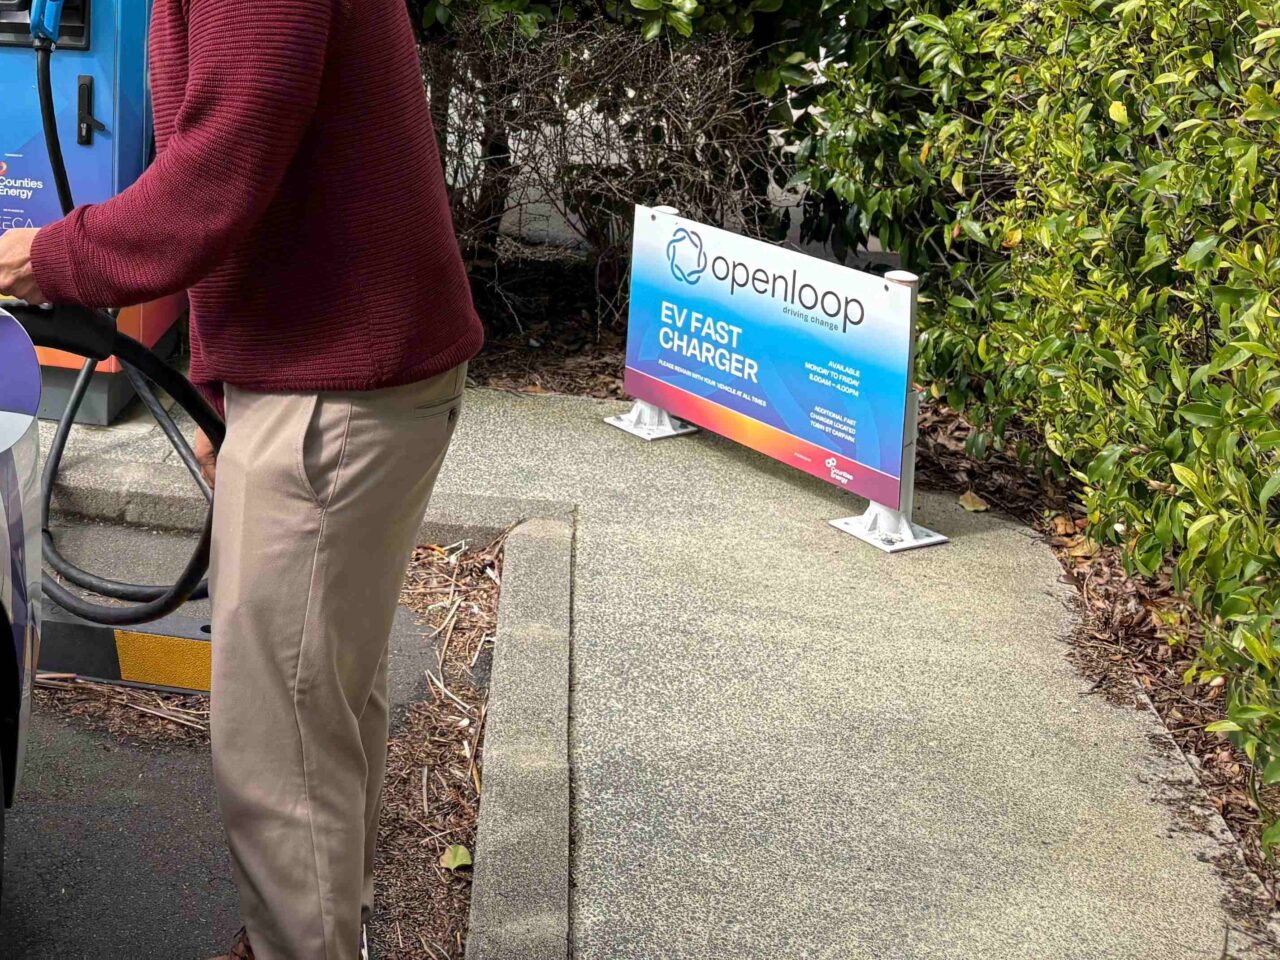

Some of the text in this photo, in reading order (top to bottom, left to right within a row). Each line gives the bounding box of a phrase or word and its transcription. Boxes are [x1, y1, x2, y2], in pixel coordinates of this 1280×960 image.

[711, 255, 865, 334] openloop
[660, 300, 743, 349] EV FAST
[782, 306, 839, 331] driving change
[659, 326, 759, 384] CHARGER
[827, 360, 861, 378] AVAILABLE
[657, 358, 675, 370] PLEASE
[703, 377, 717, 387] YOUR
[716, 382, 737, 395] VEHICLE
[742, 392, 752, 401] ALL
[804, 361, 860, 387] MONDAY TO FRIDAY
[833, 421, 856, 435] LOCATED
